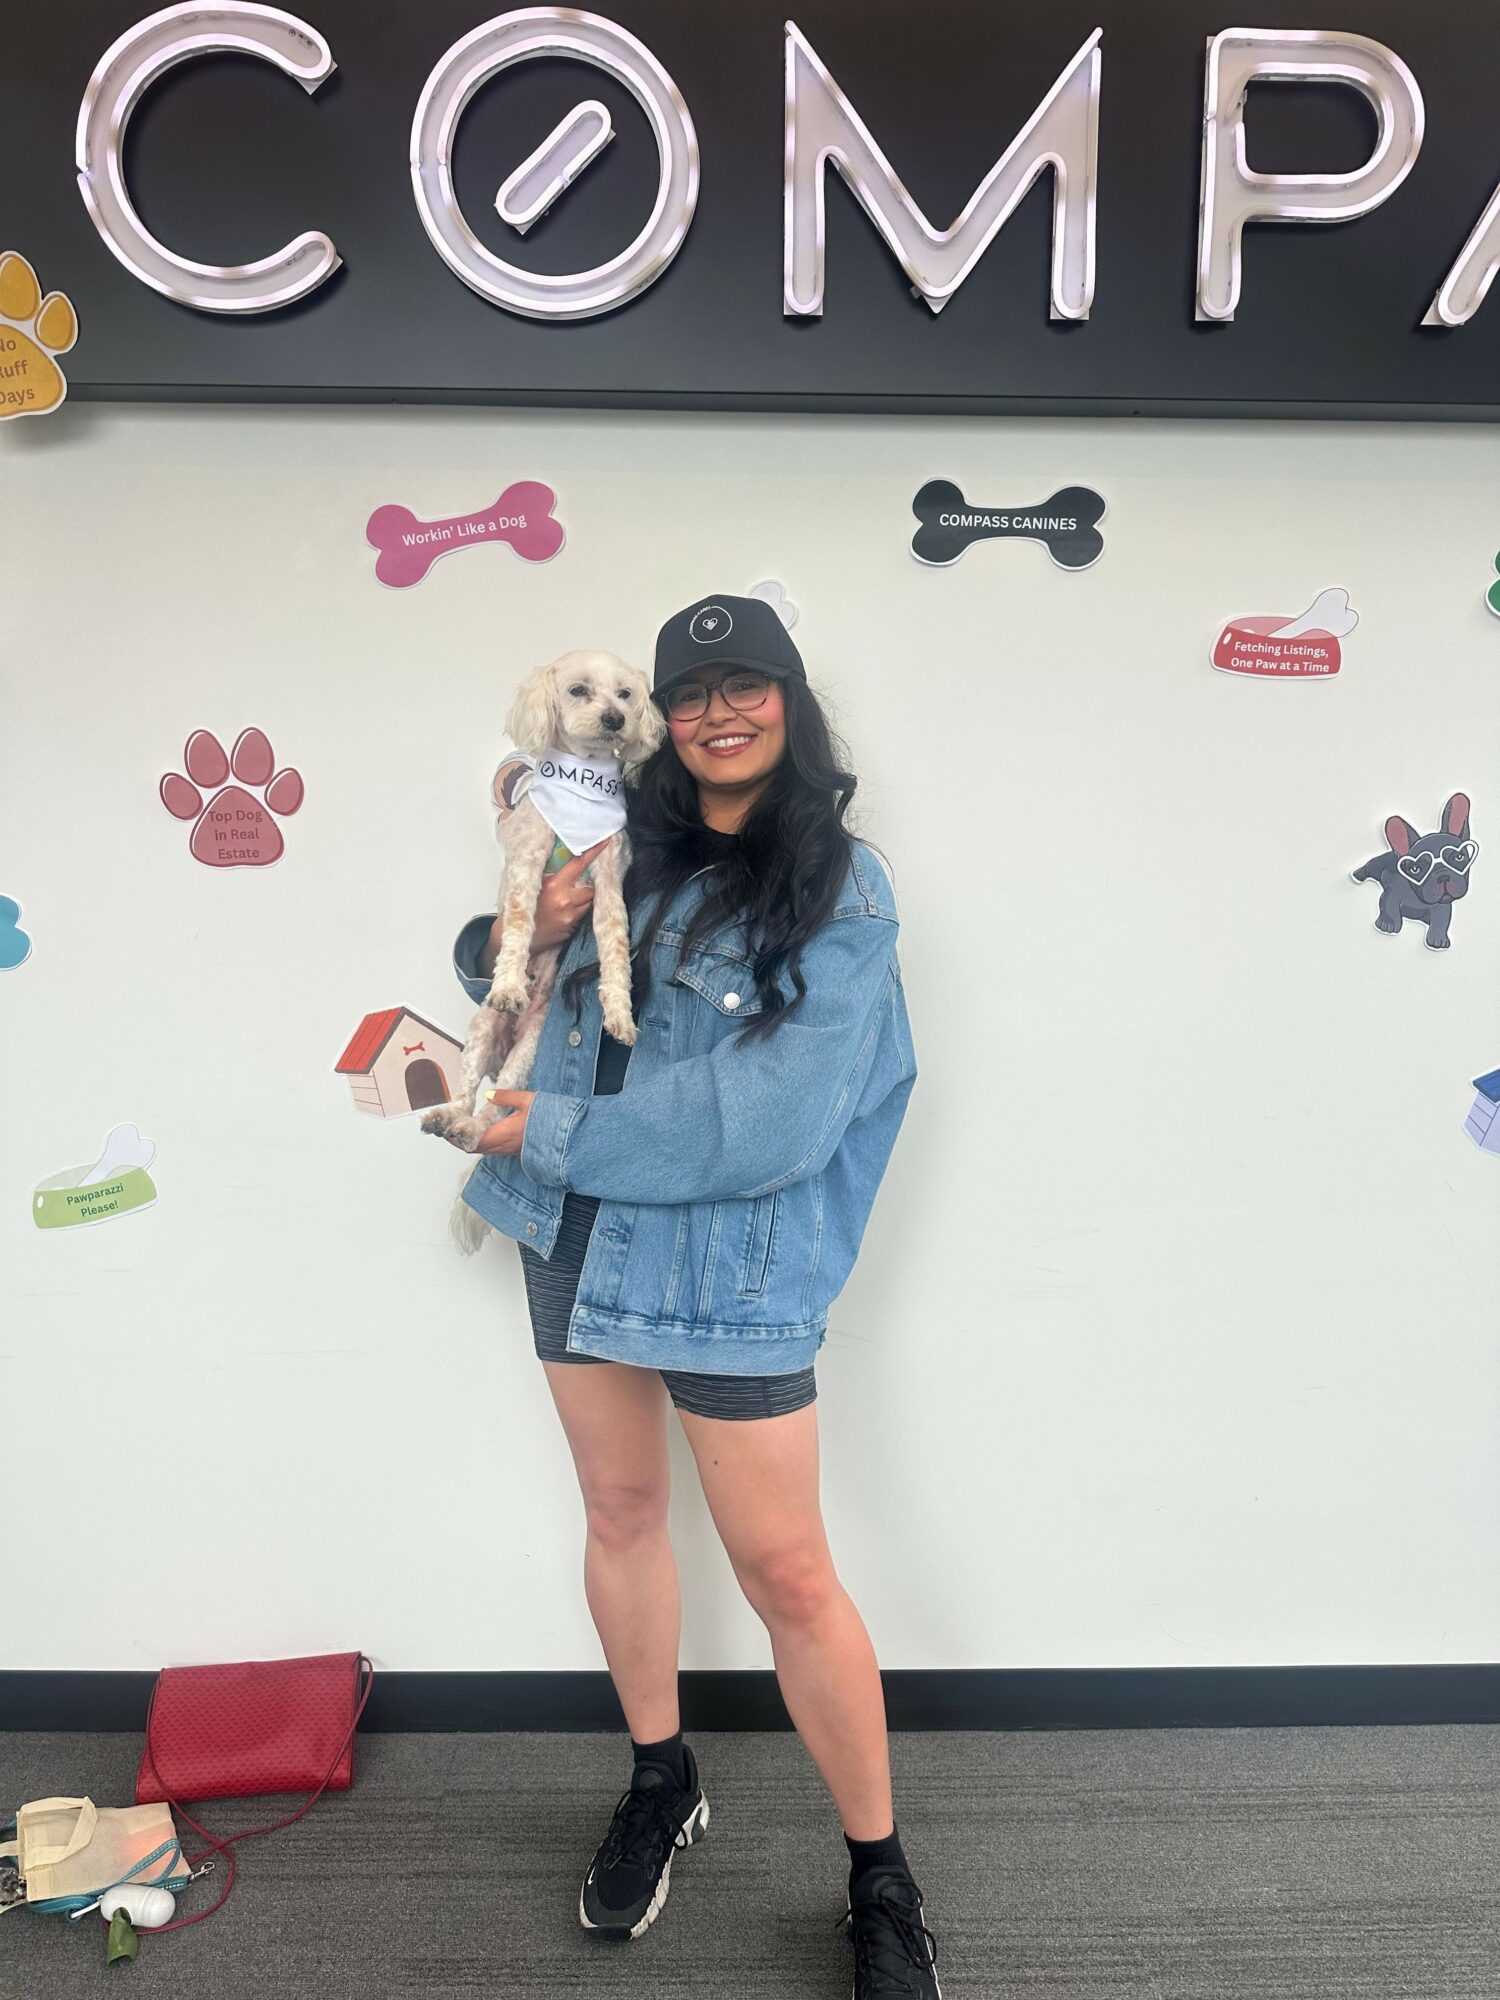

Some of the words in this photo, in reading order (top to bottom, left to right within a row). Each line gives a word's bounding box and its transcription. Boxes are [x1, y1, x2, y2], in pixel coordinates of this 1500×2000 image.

[76, 0, 1500, 326] COMP
[402, 526, 454, 546] Workin'
[457, 523, 485, 537] Like
[488, 521, 497, 531] a
[499, 514, 528, 529] Dog
[939, 513, 1009, 528] COMPASS
[1012, 516, 1077, 531] CANINES
[1234, 641, 1281, 656] Fetching
[1283, 644, 1329, 659] Listings,
[1231, 657, 1253, 668] One
[1255, 658, 1277, 670] Paw
[1279, 660, 1290, 670] at
[1293, 663, 1300, 671] a
[1303, 661, 1330, 673] Time
[539, 761, 622, 796] OMPASS
[208, 811, 232, 824] Top
[236, 810, 263, 823] Dog
[214, 829, 227, 841] in
[231, 828, 260, 840] Real
[218, 848, 260, 859] Estate
[66, 1182, 124, 1205] Pawparazzi
[80, 1200, 119, 1217] Please!
